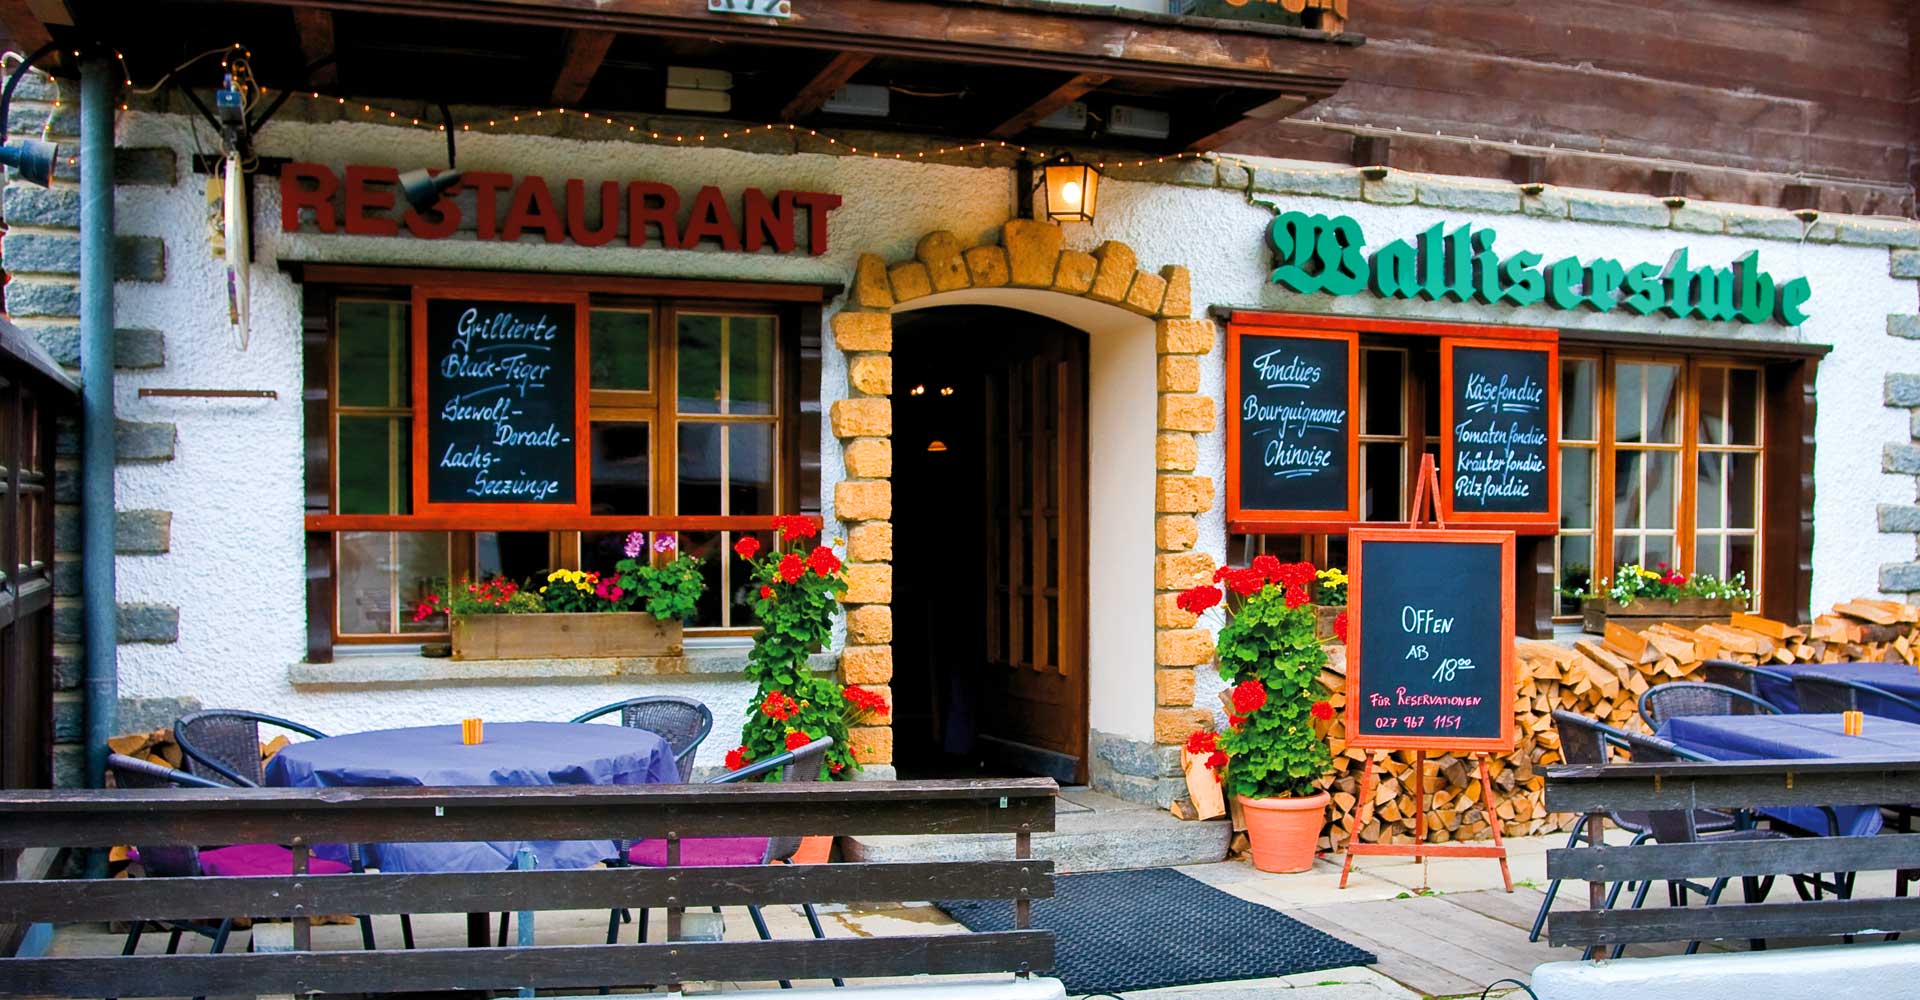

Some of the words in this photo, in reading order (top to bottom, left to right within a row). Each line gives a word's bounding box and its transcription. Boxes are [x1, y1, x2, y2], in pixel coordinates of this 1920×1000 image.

[1266, 210, 1812, 326] Walliserstube
[452, 307, 557, 352] Grillierte
[440, 353, 550, 398] Black-Tiger
[1243, 394, 1345, 439] Bourguignonne
[499, 422, 570, 446] Dorade-
[440, 442, 500, 468] Lachs-
[1264, 439, 1331, 467] Chinoise
[1405, 644, 1429, 660] AB
[1375, 717, 1397, 728] 027
[1403, 715, 1424, 728] 967
[1433, 714, 1462, 730] 1151
